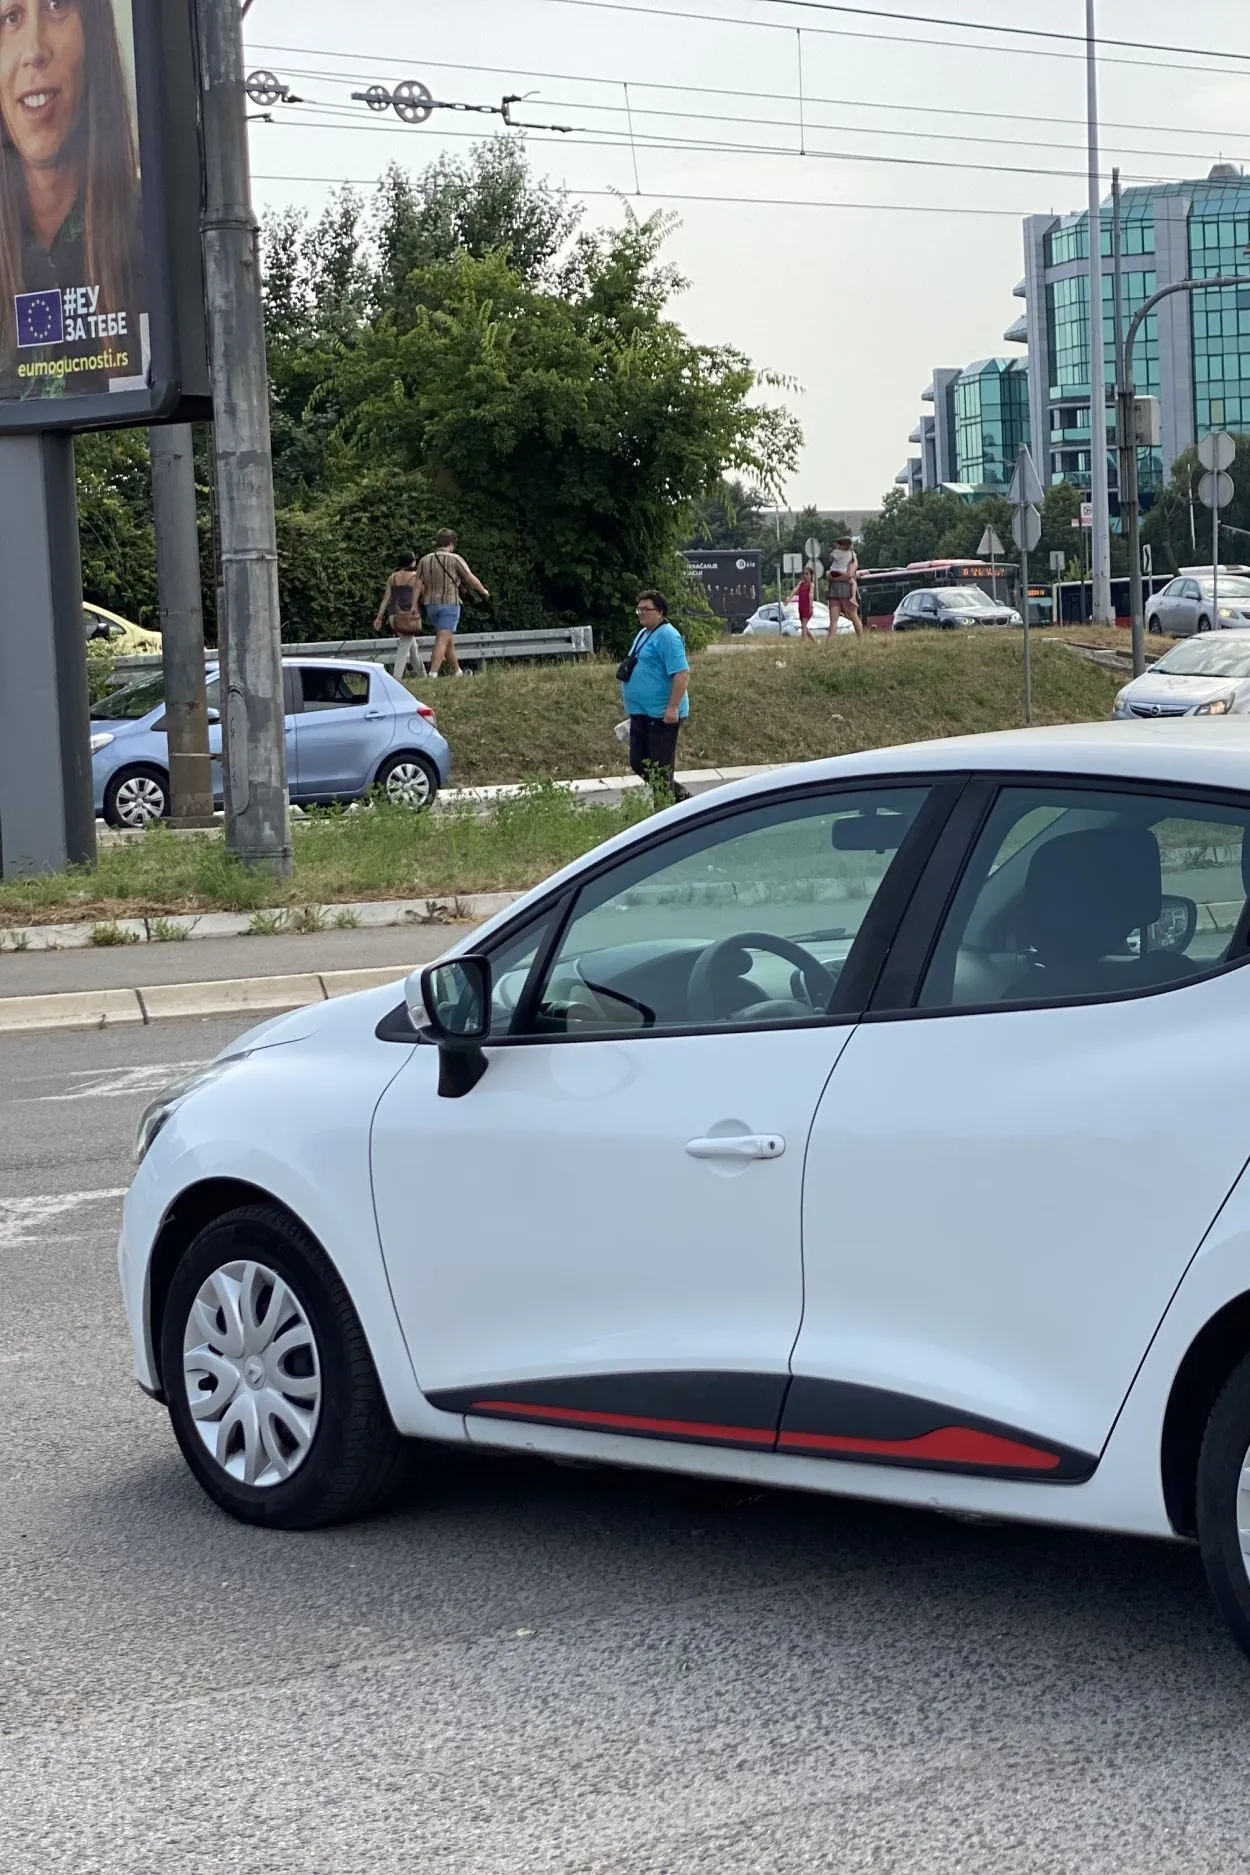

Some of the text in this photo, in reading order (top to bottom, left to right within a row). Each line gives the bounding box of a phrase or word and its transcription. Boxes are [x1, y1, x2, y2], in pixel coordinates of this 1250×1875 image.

[64, 285, 100, 316] #ЕУ
[65, 312, 127, 341] ЗА ТЕБЕ
[18, 349, 128, 378] eumogucnosti.rs
